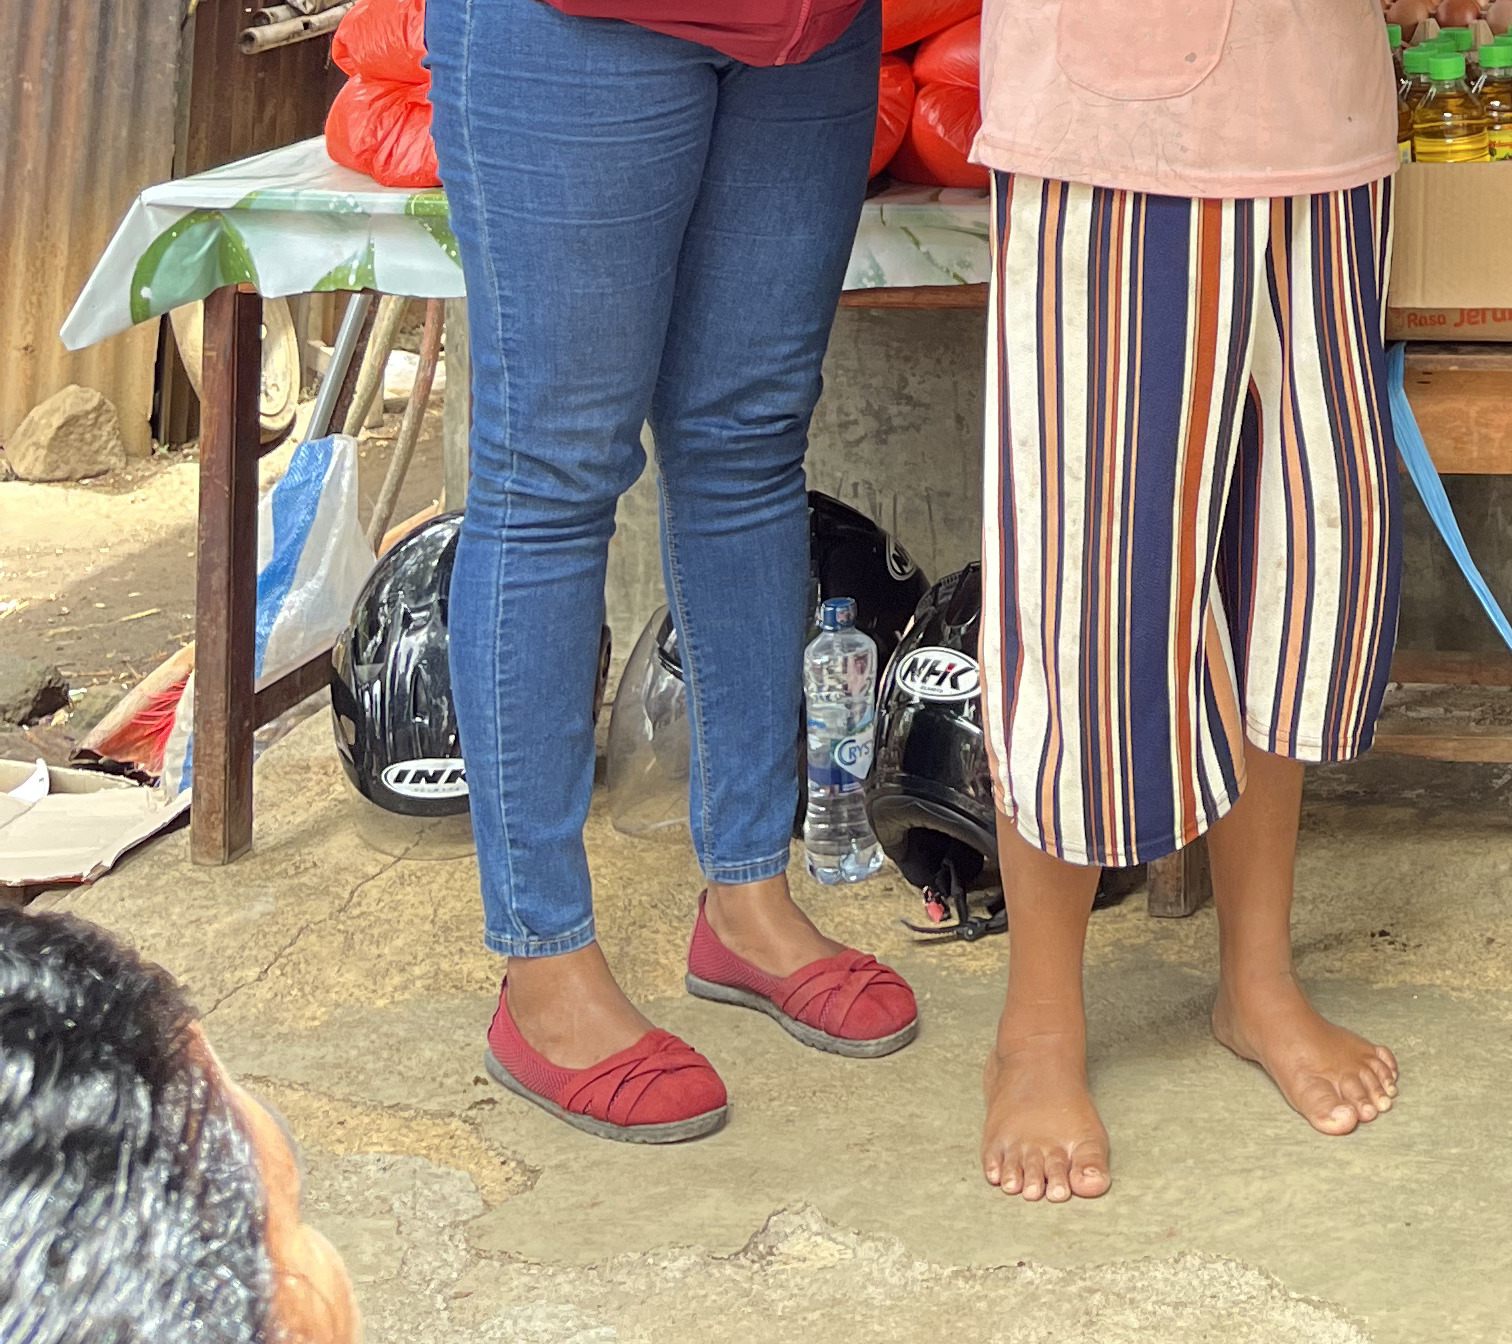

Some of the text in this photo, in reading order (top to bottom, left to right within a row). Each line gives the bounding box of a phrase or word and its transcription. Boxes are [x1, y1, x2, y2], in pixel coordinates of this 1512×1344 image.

[1407, 312, 1447, 328] Rasa
[902, 657, 976, 691] NHK
[393, 769, 467, 784] INK
